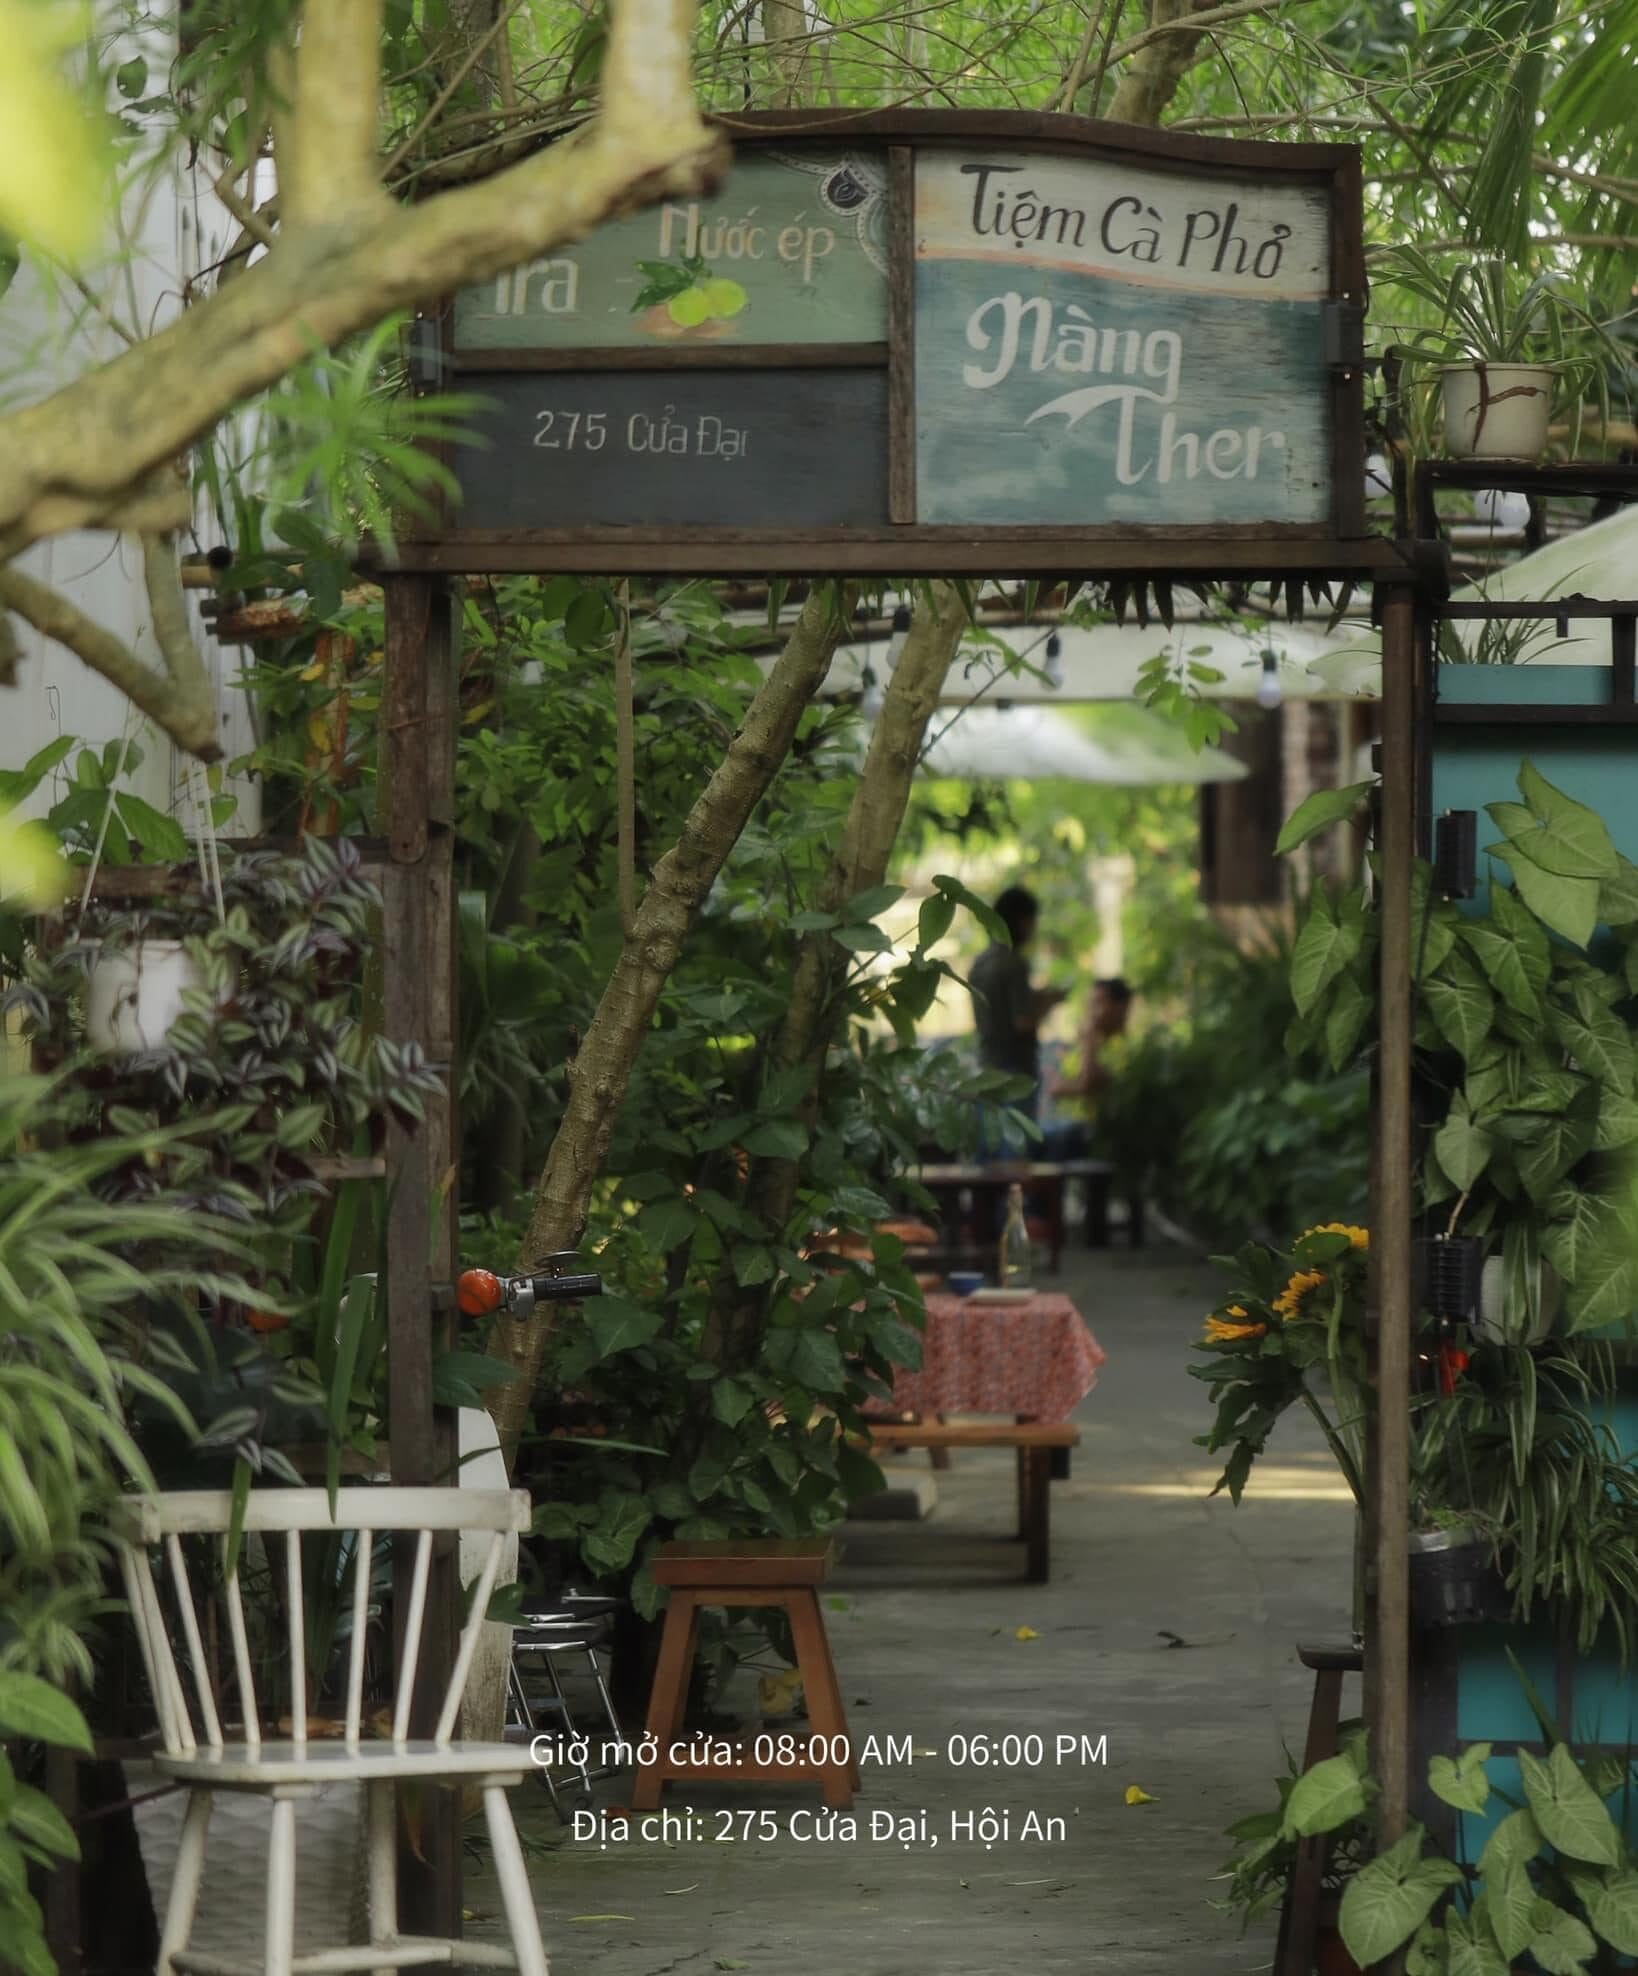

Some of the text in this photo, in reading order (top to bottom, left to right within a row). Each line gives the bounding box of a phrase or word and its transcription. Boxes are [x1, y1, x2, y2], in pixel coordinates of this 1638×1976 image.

[778, 210, 836, 283] ép
[959, 163, 1086, 249] Tiệm
[1100, 195, 1162, 263] Cà
[963, 292, 1182, 403] Nàng
[533, 404, 748, 461] 275 Cửa Đại
[1023, 384, 1287, 486] Ther
